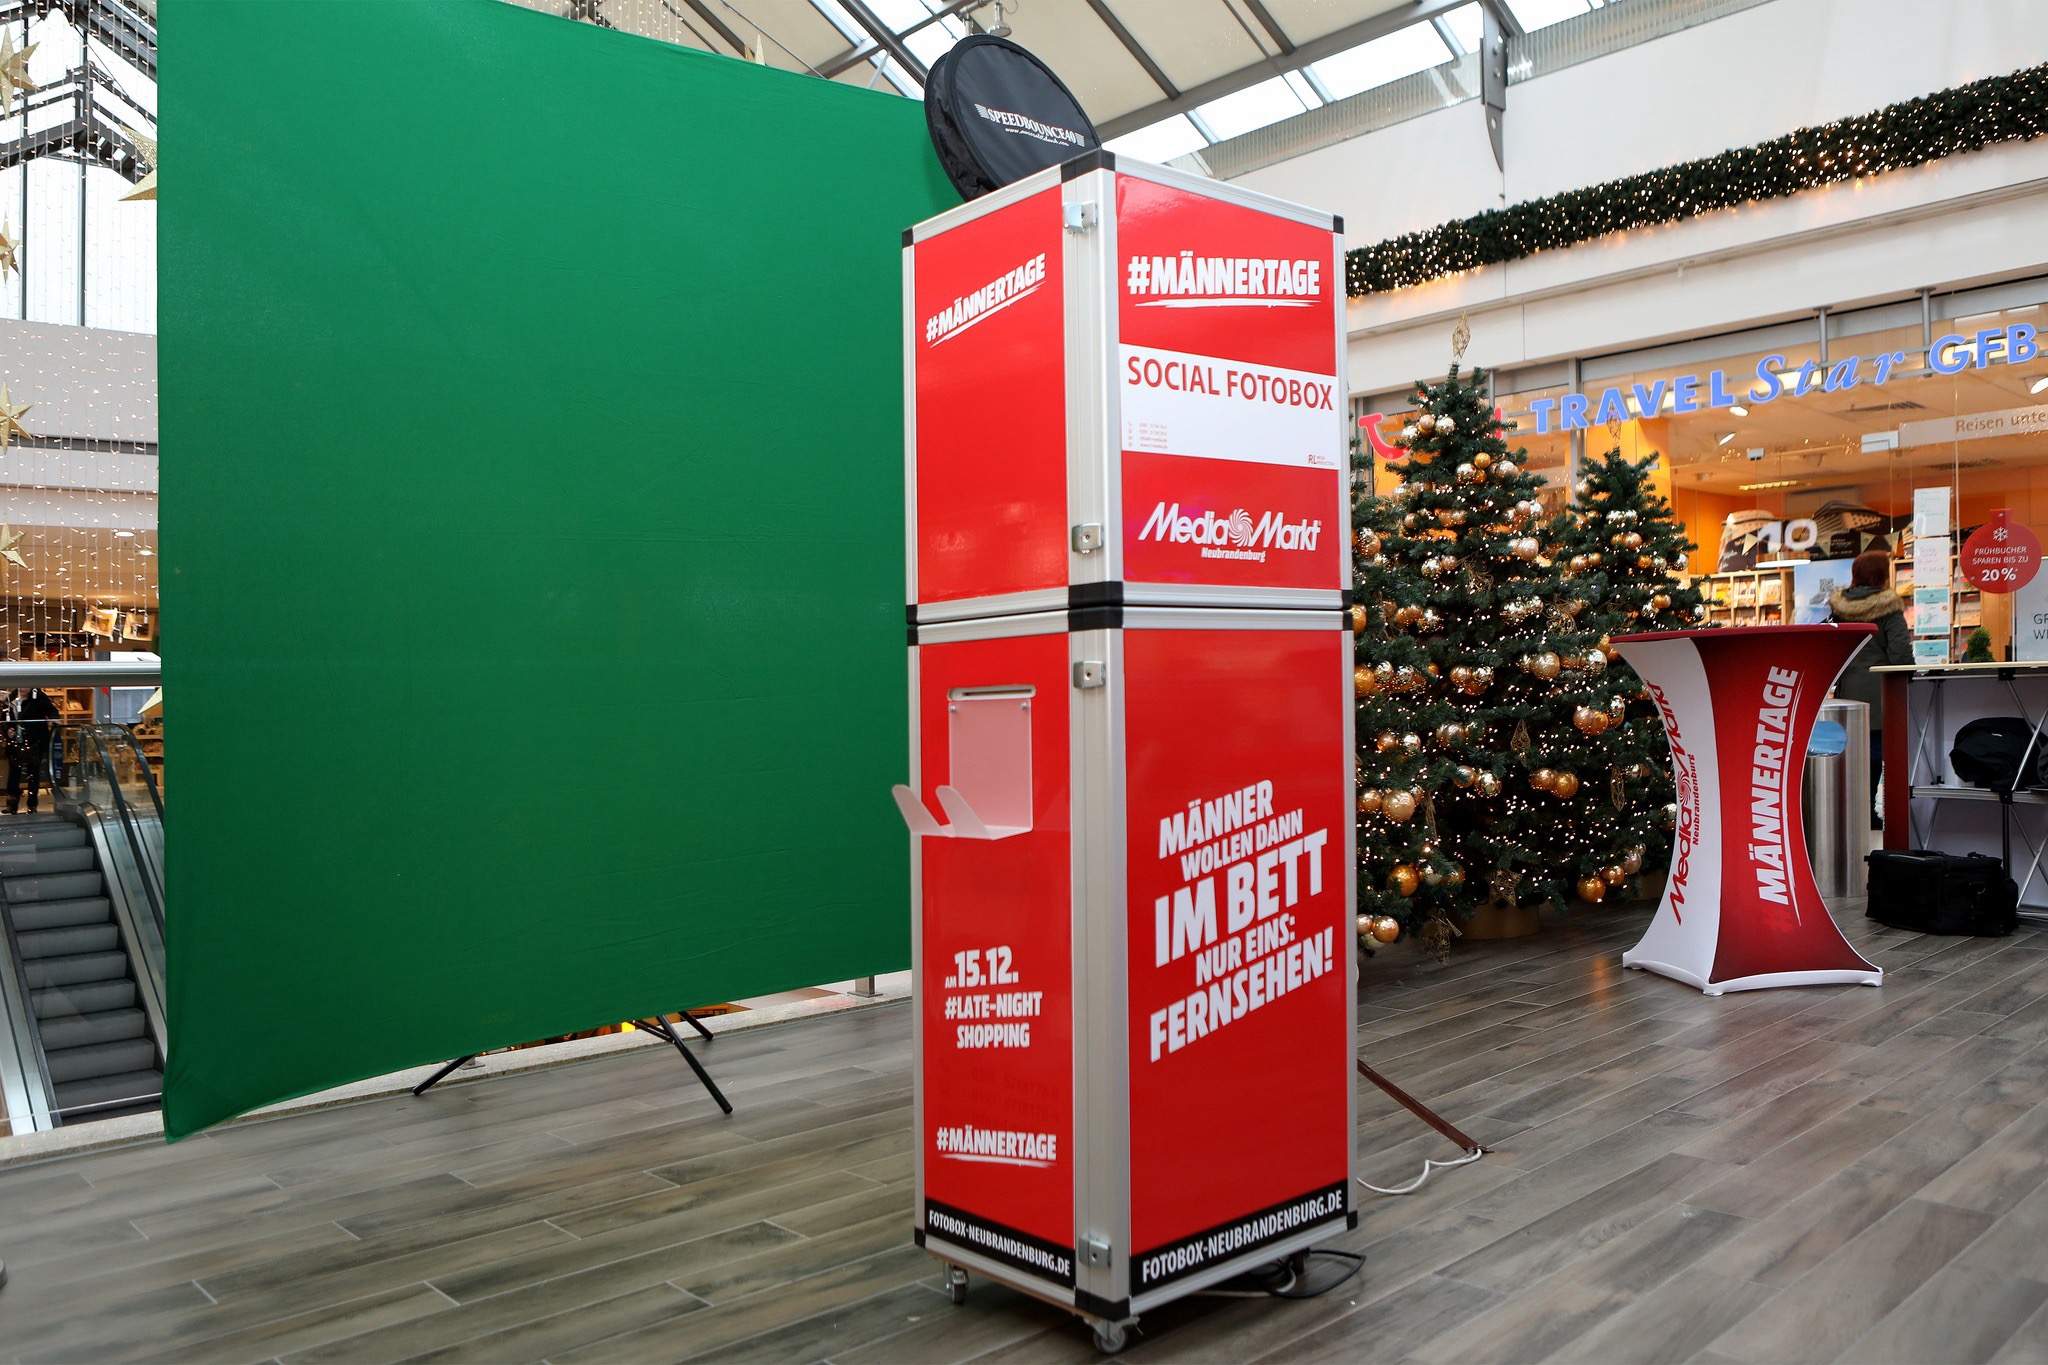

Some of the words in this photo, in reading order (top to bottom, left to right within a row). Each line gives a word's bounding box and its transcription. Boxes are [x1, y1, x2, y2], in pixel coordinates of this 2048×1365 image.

[987, 108, 1077, 144] SPEEDBOUNCE40
[926, 252, 1046, 343] #MÄNNERTAGE
[1127, 250, 1320, 295] #MÄNNERTAGE
[1127, 355, 1220, 396] SOCIAL
[1227, 369, 1334, 411] FOTOBOX
[1530, 370, 1736, 434] TRAVEL
[1749, 350, 1905, 404] Star
[1929, 322, 2039, 376] GFB
[1955, 417, 2004, 433] Reisen
[1201, 547, 1266, 563] Neubrandenburg
[1972, 557, 2002, 566] SPAREN
[2003, 555, 2016, 564] BIS
[2017, 555, 2029, 563] ZU
[1158, 779, 1274, 860] MÄNNER
[1687, 753, 1700, 846] Neubrandenburg
[1180, 828, 1254, 882] WOLLEN
[1255, 808, 1303, 852] DANN
[1154, 876, 1218, 969] IM
[1227, 828, 1328, 935] BETT
[954, 945, 1019, 988] 15.12.
[1196, 936, 1242, 987] NUR
[1245, 912, 1296, 963] EINS:
[944, 991, 1043, 1020] #LATE-NIGHT
[1150, 925, 1334, 1063] FERNSEHEN!
[956, 1022, 1031, 1049] SHOPPING
[936, 1124, 1057, 1161] #MÄNNERTAGE
[929, 1209, 1070, 1277] FOTOBOX-NEUBRANDENBURG.DE
[1142, 1189, 1342, 1283] FOTOBOX-NEUBRANDENBURG.DE
